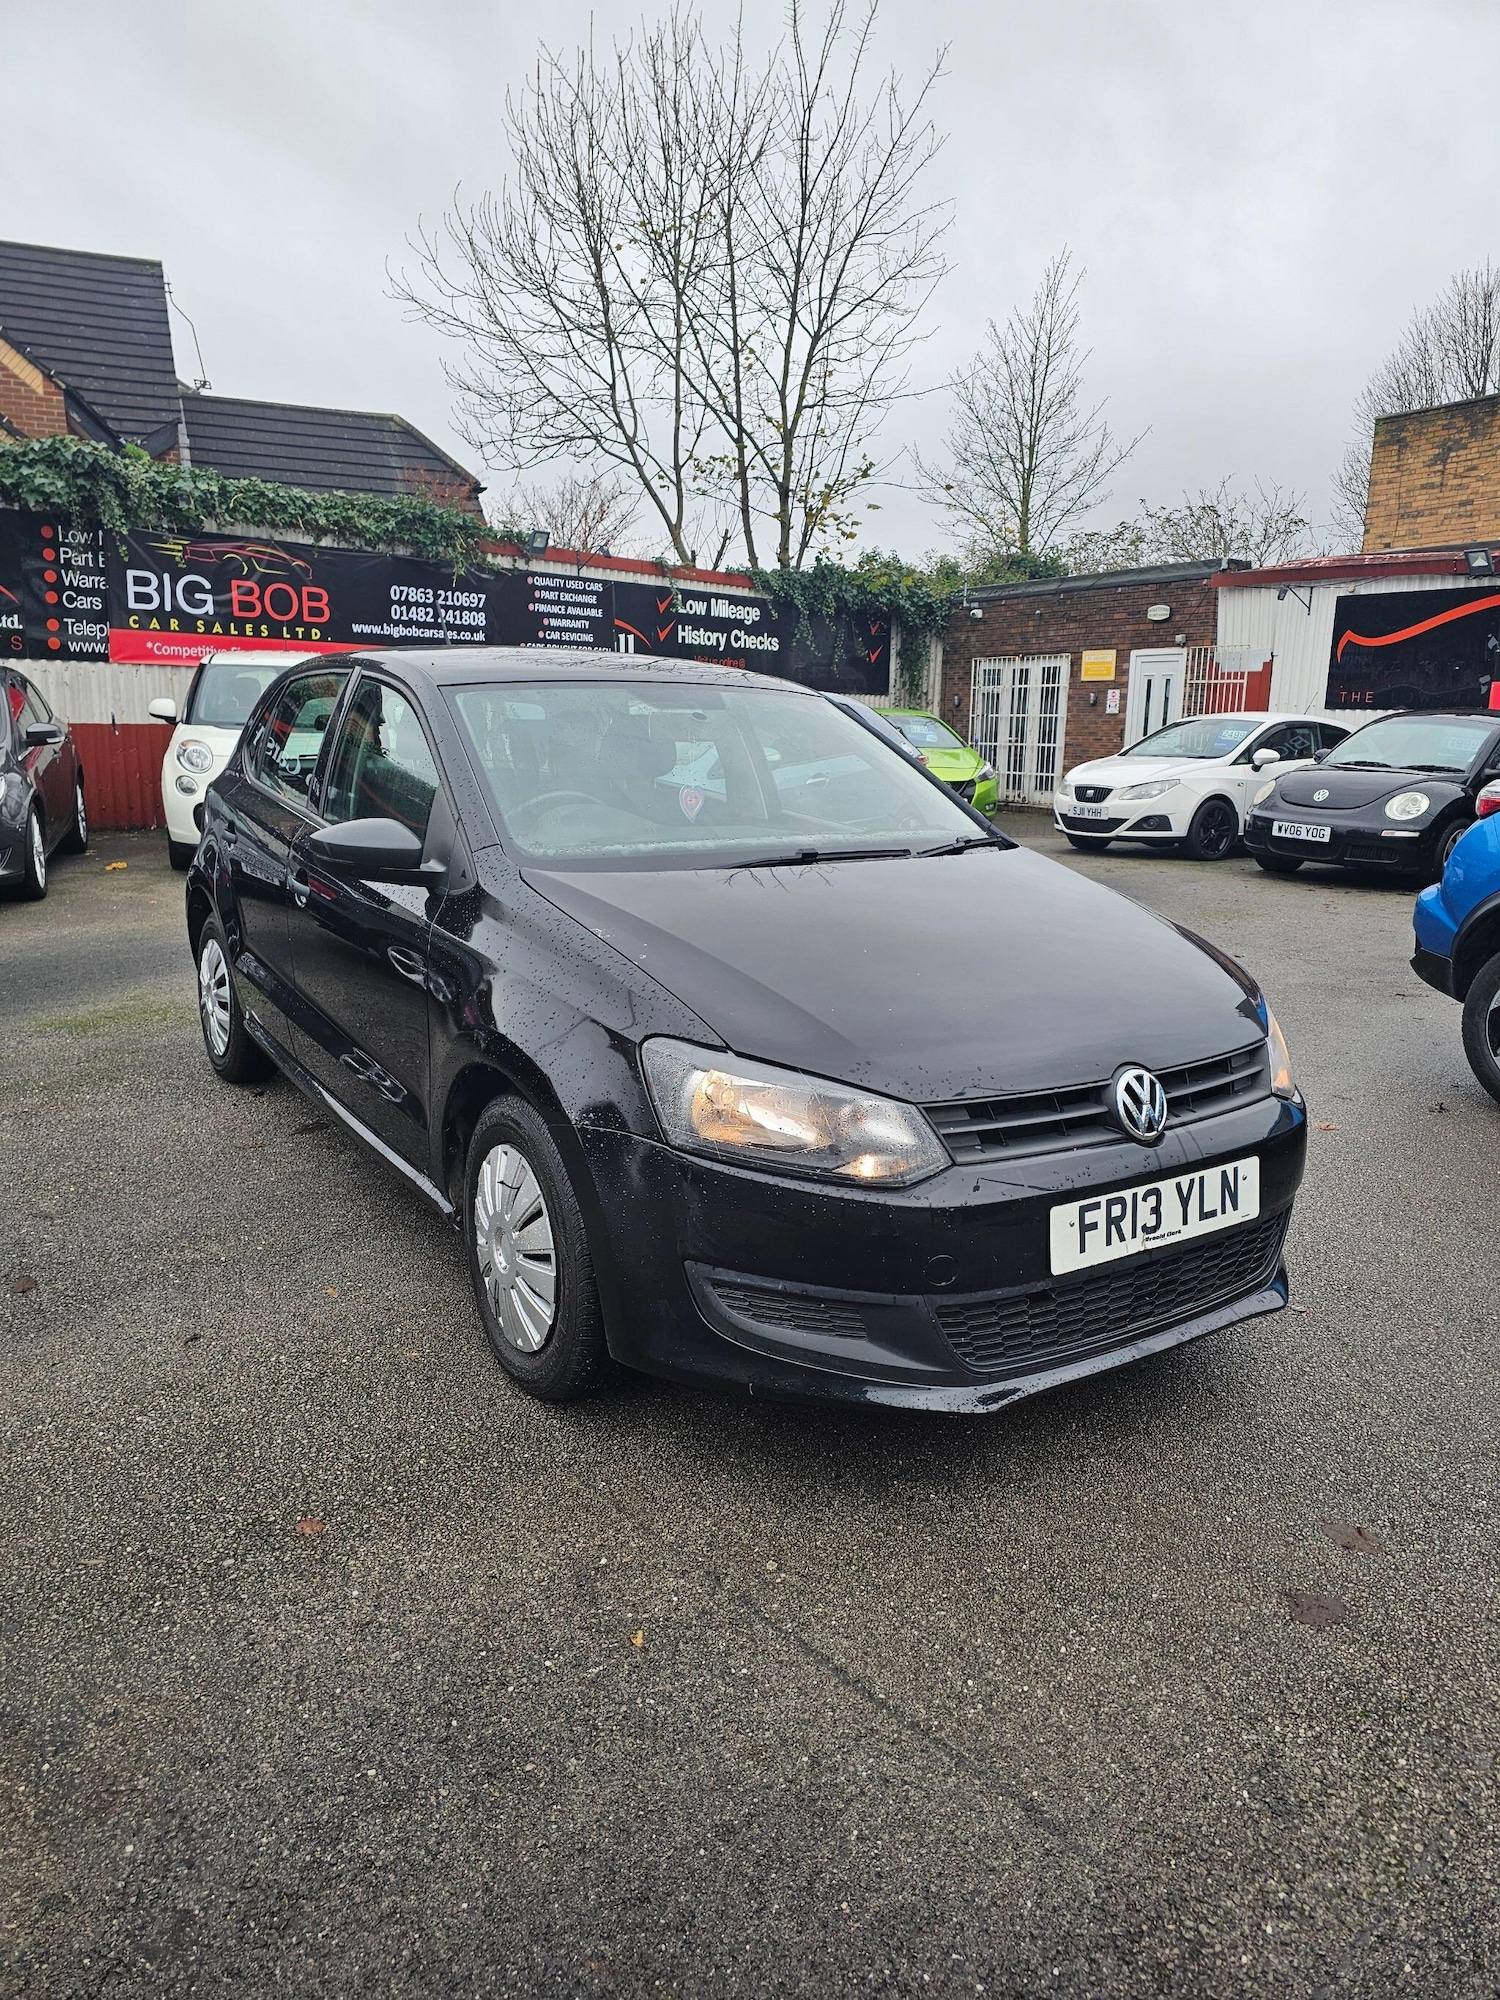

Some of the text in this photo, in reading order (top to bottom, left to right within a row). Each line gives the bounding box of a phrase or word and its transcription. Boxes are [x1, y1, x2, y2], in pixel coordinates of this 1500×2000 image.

[60, 547, 94, 567] Part
[534, 576, 603, 592] QUALITY USED CARS
[62, 591, 102, 610] Cars
[126, 569, 331, 624] BIG BOB
[390, 585, 486, 609] 07863 210697
[540, 590, 597, 604] PART EXCHANGE
[391, 604, 434, 623] 01482
[534, 603, 603, 618] FINANCE AVALIABLE
[677, 595, 760, 625] Low Mileage
[129, 615, 332, 642] CAR SALES LTD.
[352, 622, 486, 642] www.bigbobcarsaes.co.uk
[549, 618, 589, 629] WARRANTY
[545, 631, 594, 642] CAR SEVICING
[677, 624, 780, 652] History Checks
[1340, 691, 1374, 703] THE
[1073, 806, 1102, 818] SJ11 YHH
[1278, 823, 1326, 839] WV06 YOG
[1078, 1166, 1239, 1254] FR13 YLN
